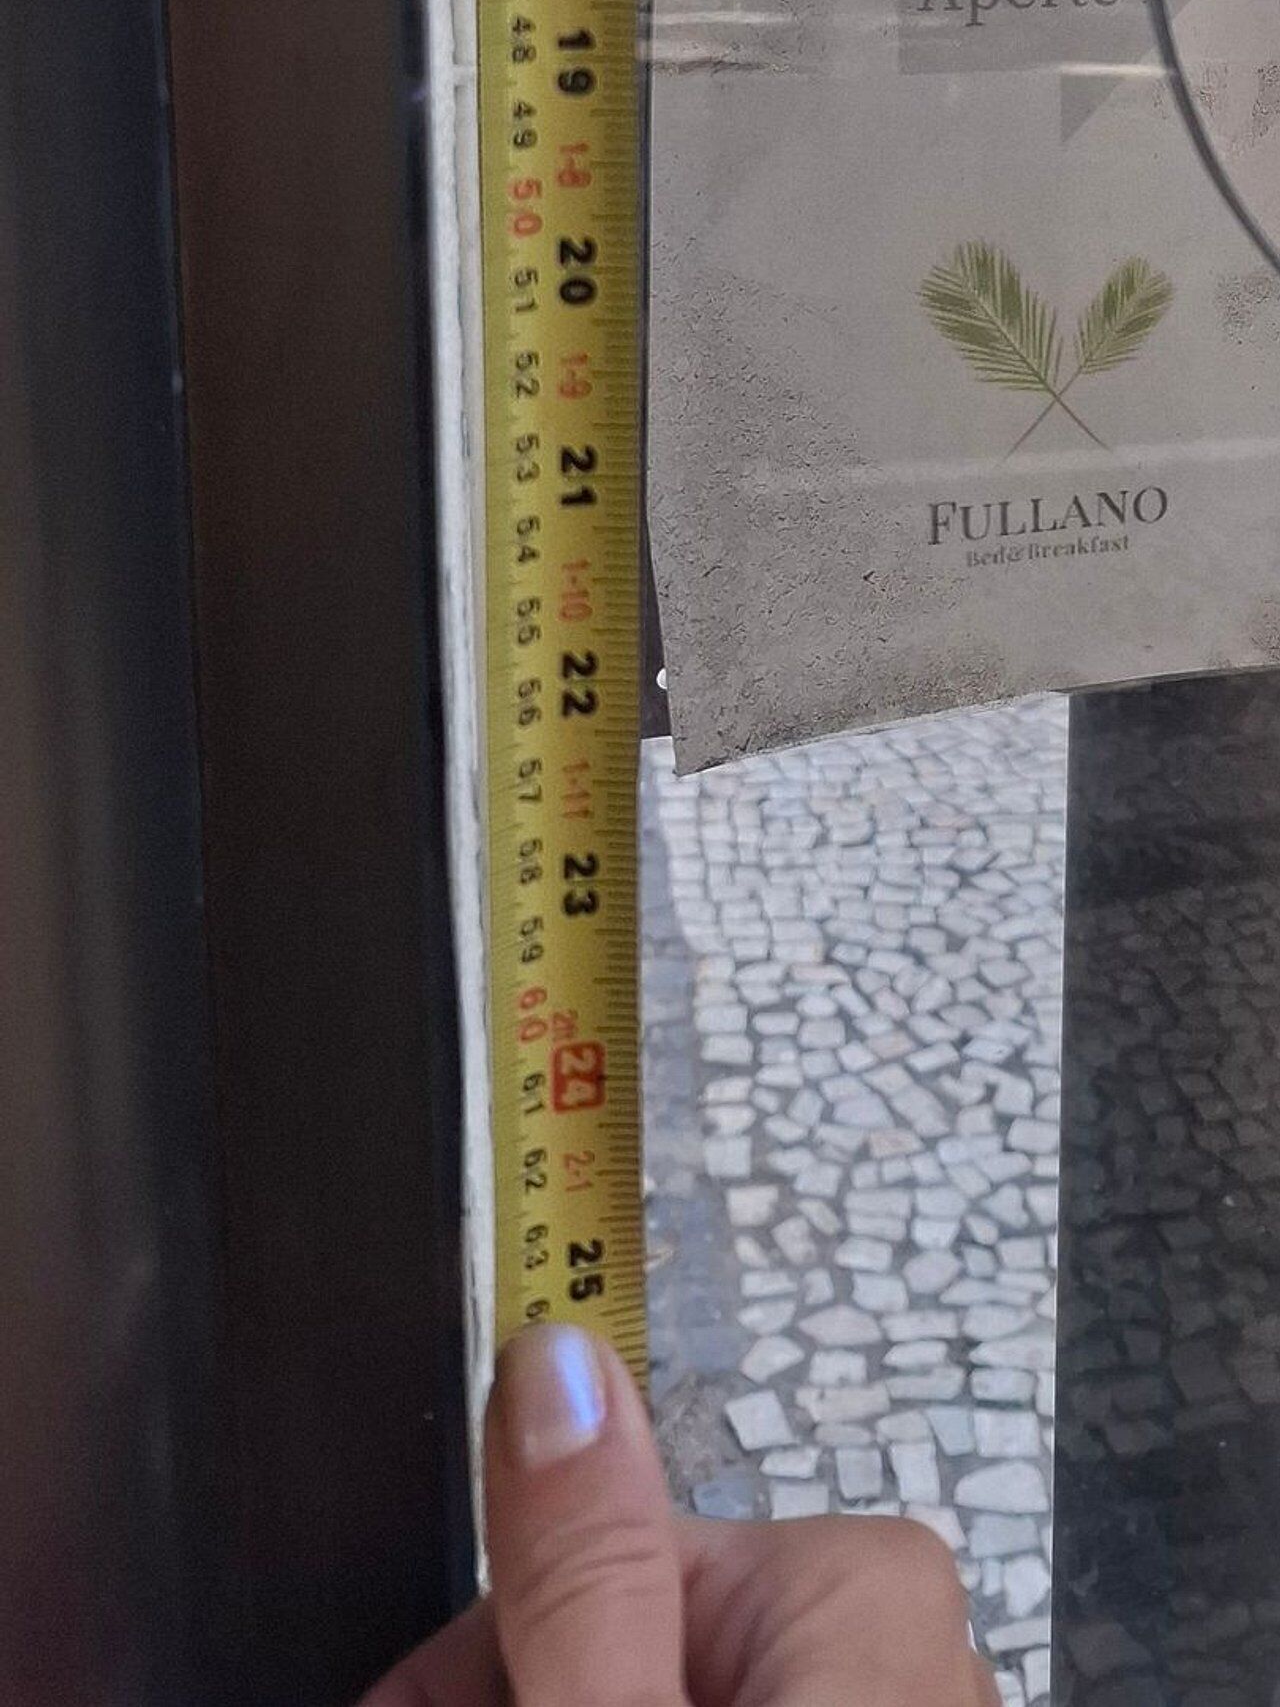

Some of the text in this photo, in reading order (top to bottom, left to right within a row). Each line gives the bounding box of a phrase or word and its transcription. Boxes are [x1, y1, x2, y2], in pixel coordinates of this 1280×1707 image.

[512, 16, 537, 65] 48
[557, 29, 597, 97] 19
[512, 102, 538, 149] 49
[508, 178, 543, 238] 50
[514, 268, 539, 315] 51
[558, 237, 598, 306] 20
[515, 352, 540, 399] 52
[515, 434, 540, 485] 53
[560, 446, 598, 508] 21
[516, 516, 540, 564] 54
[928, 486, 1168, 545] FULLANO
[516, 597, 541, 646] 55
[517, 678, 542, 728] 56
[560, 650, 599, 719] 22
[518, 758, 542, 805] 57
[519, 838, 543, 887] 58
[562, 853, 600, 918] 23
[519, 916, 544, 965] 59
[517, 986, 548, 1044] 60
[523, 1073, 549, 1116] 61
[558, 1046, 599, 1109] 24
[523, 1148, 548, 1191] 62
[525, 1224, 549, 1271] 63
[567, 1238, 605, 1303] 25
[525, 1299, 551, 1326] 6
